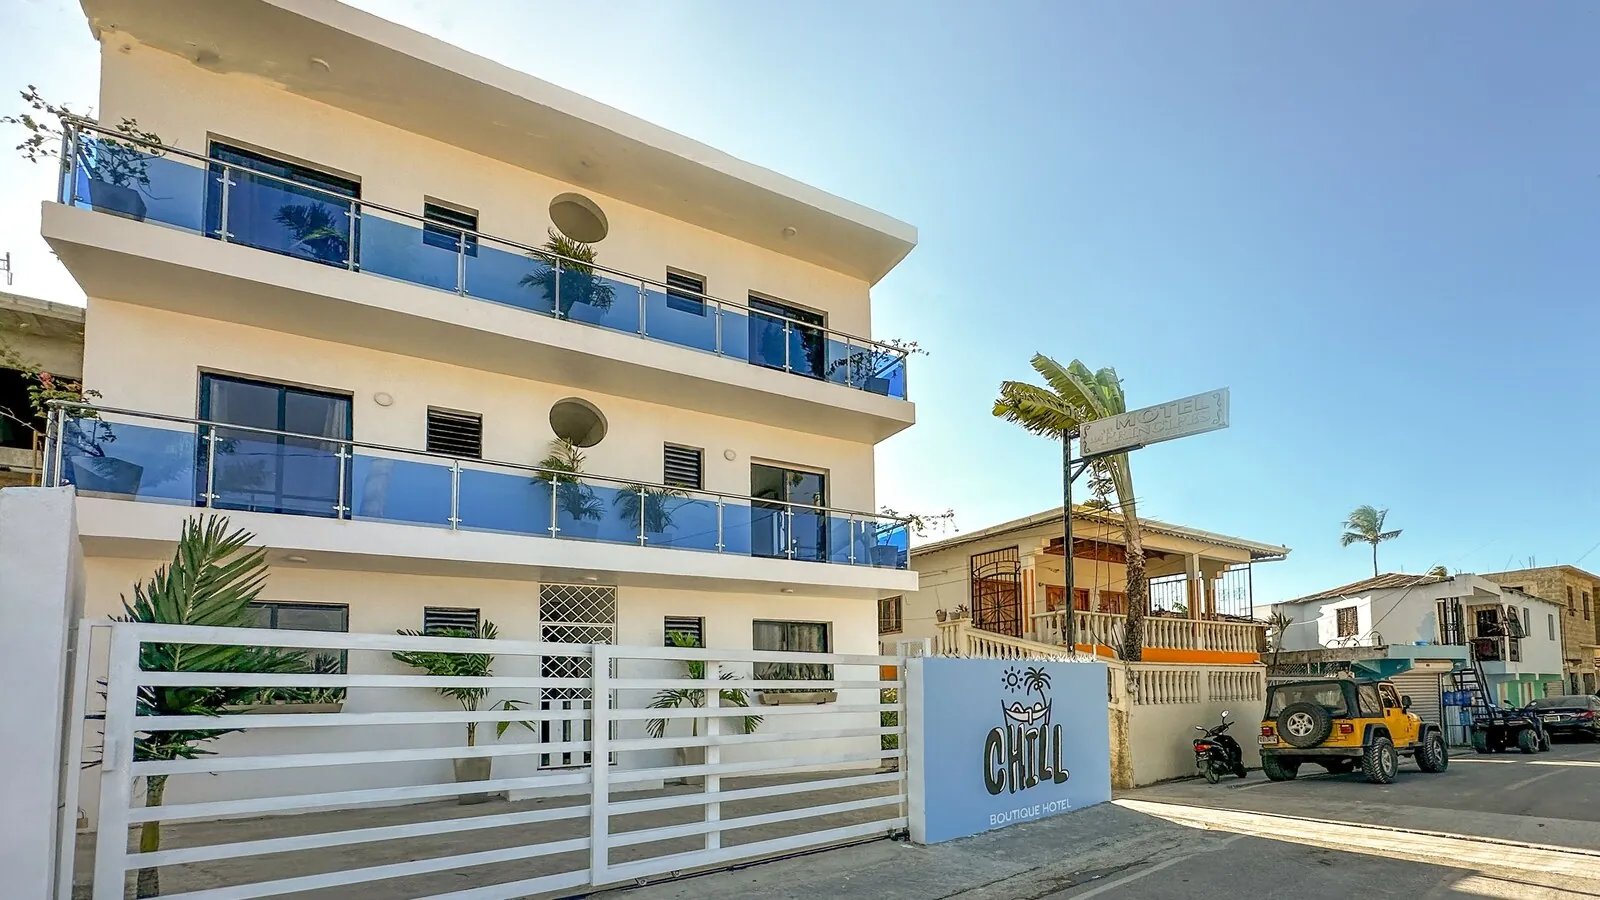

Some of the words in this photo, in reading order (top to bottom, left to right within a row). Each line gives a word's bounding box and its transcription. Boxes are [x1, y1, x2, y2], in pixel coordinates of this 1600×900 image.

[1116, 397, 1209, 430] MOTEL
[984, 723, 1069, 795] CHILL
[990, 805, 1040, 825] BOUTIQUE
[1042, 799, 1072, 813] HOTEL
